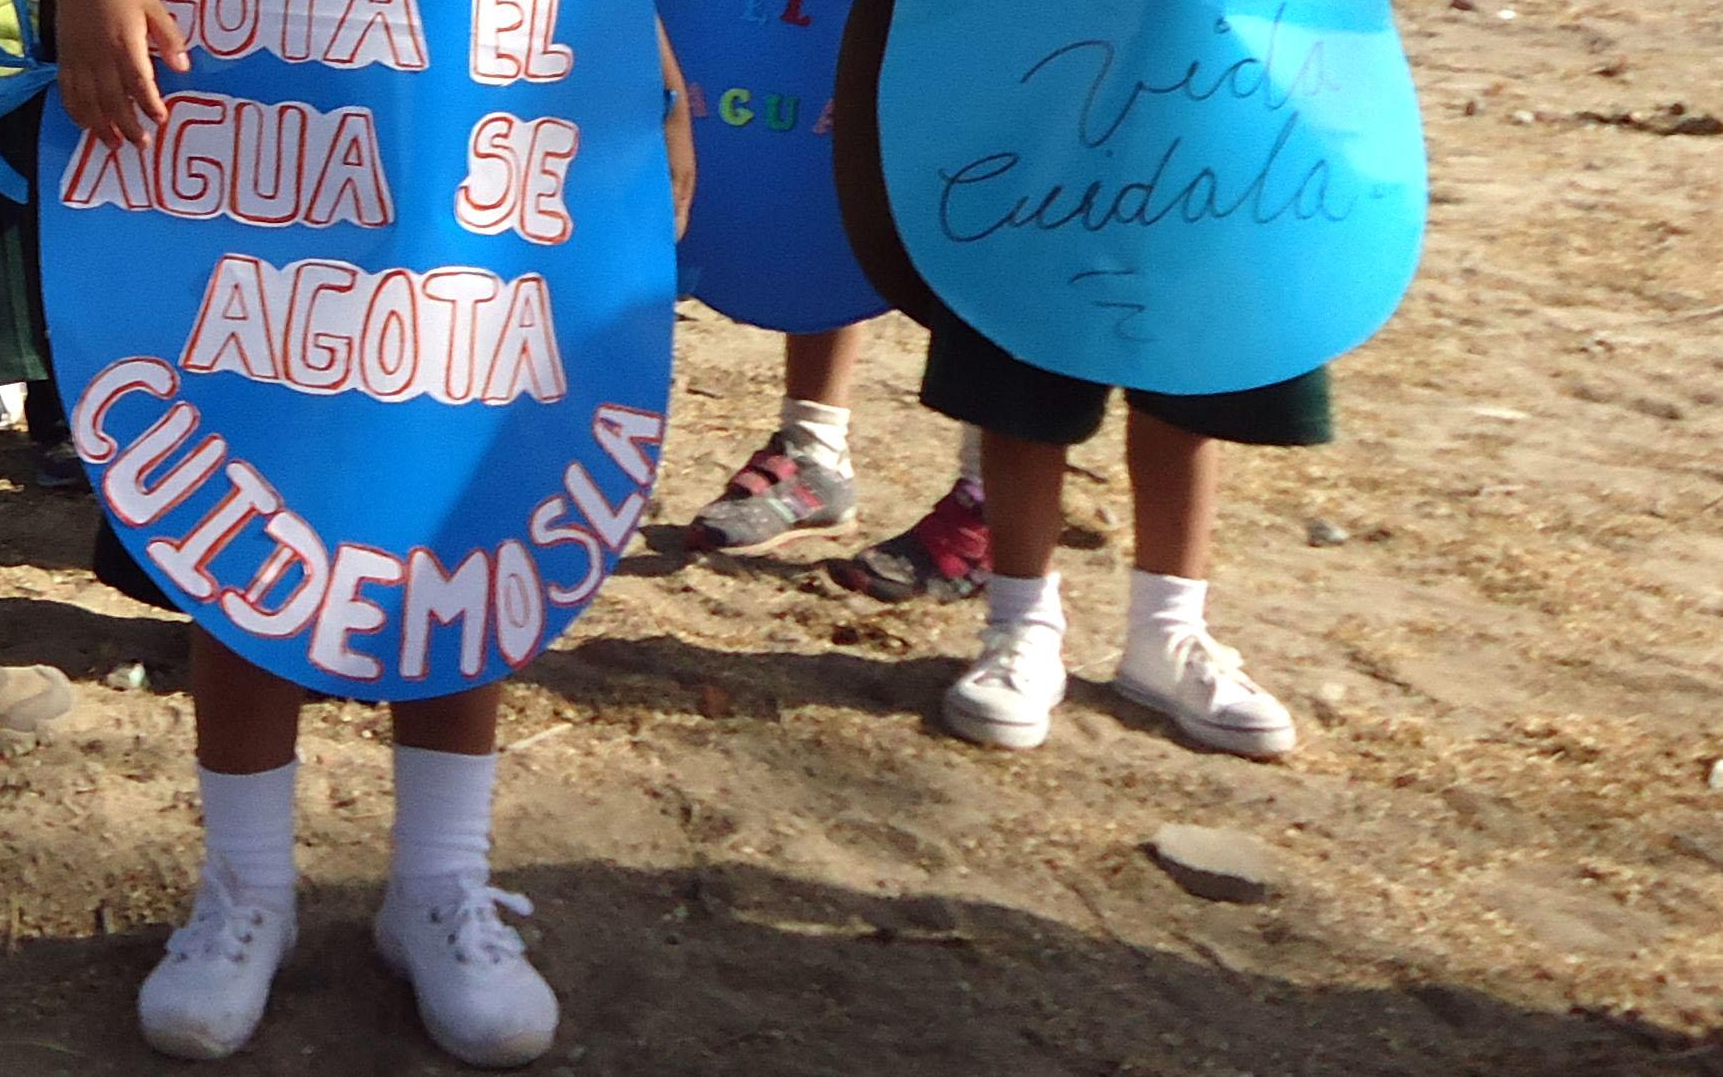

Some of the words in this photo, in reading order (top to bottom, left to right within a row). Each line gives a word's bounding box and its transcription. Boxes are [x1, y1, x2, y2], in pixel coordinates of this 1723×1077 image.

[1021, 3, 1341, 148] Vida
[59, 92, 394, 227] AGUA
[455, 112, 579, 245] SE
[938, 111, 1356, 243] Cuidala
[180, 253, 567, 406] AGOTA
[71, 356, 667, 681] CUIDEMOSLA
